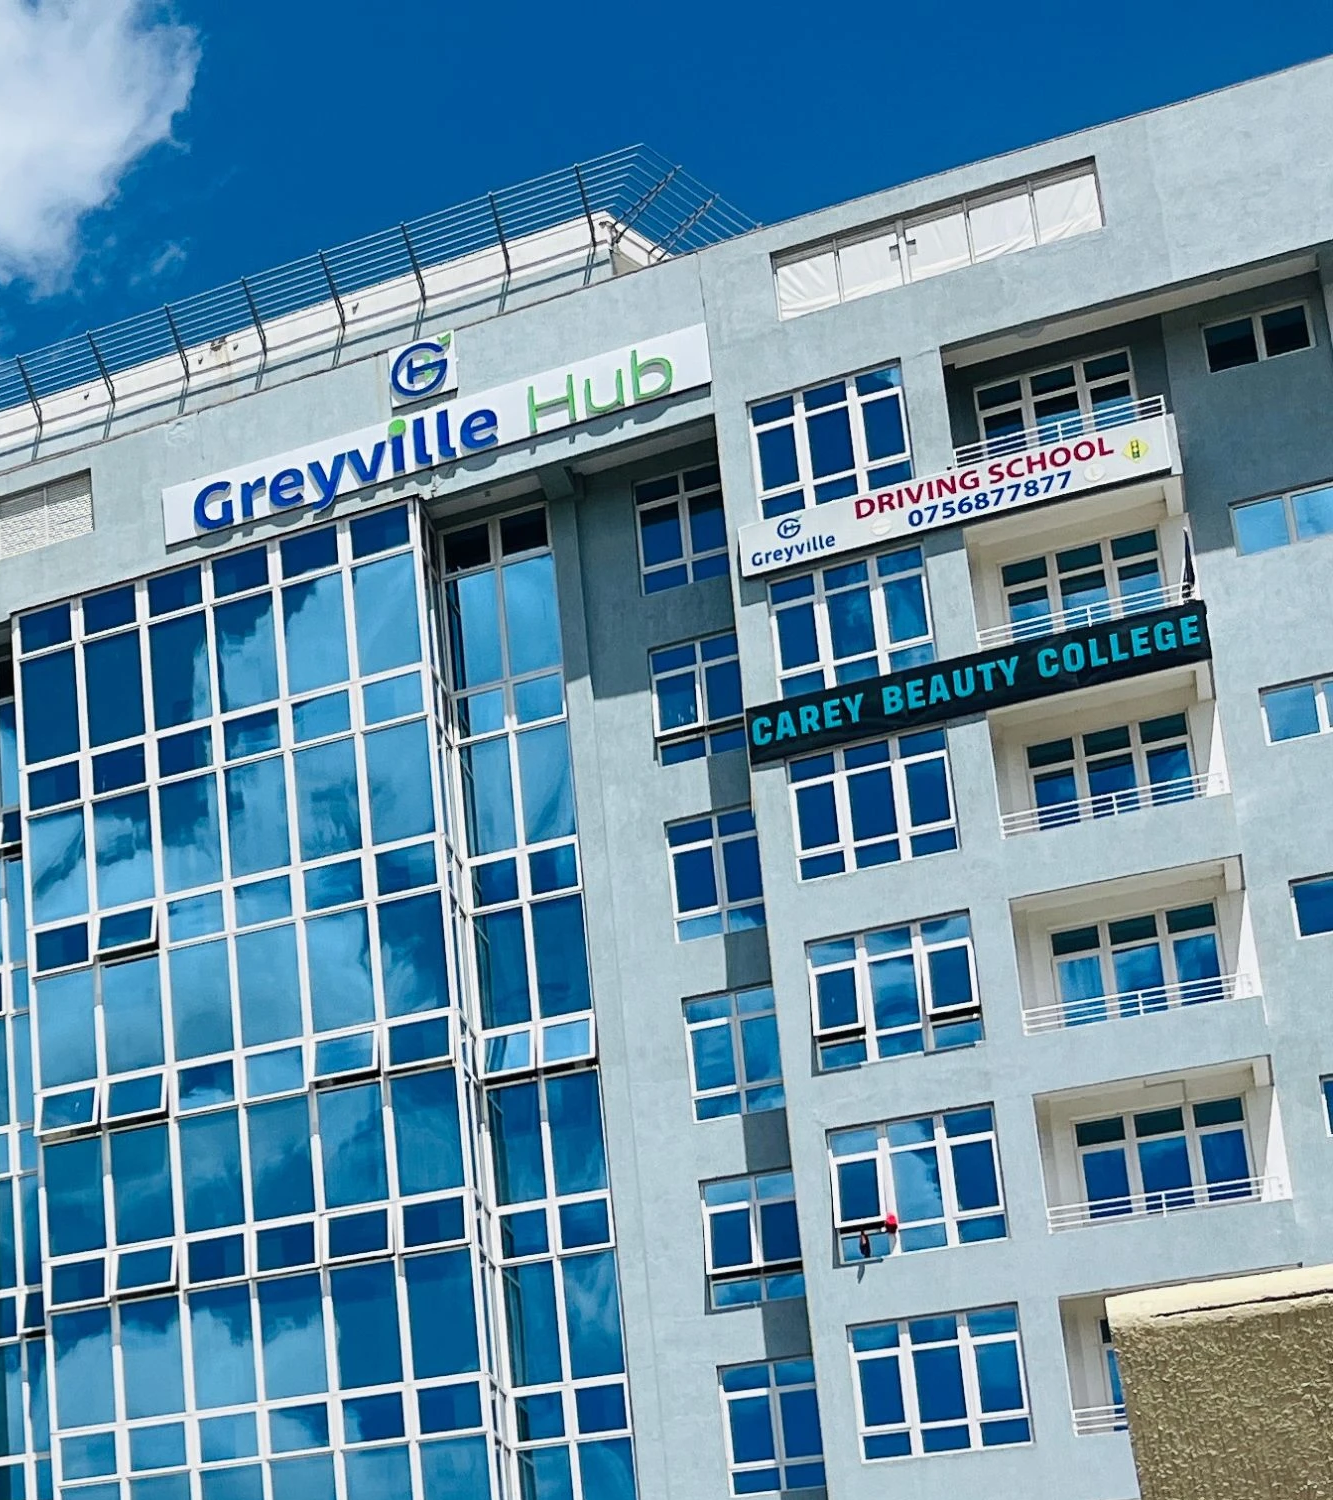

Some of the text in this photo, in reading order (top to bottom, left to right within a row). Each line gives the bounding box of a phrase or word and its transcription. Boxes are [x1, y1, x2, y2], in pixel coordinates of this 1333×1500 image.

[194, 348, 674, 531] Greyville Hub
[854, 437, 1114, 521] DRIVING SCHOOL
[908, 470, 1072, 527] 0756877877
[752, 533, 836, 568] Greyville
[752, 614, 1202, 747] CAREY BEAUTY COLLEGE
